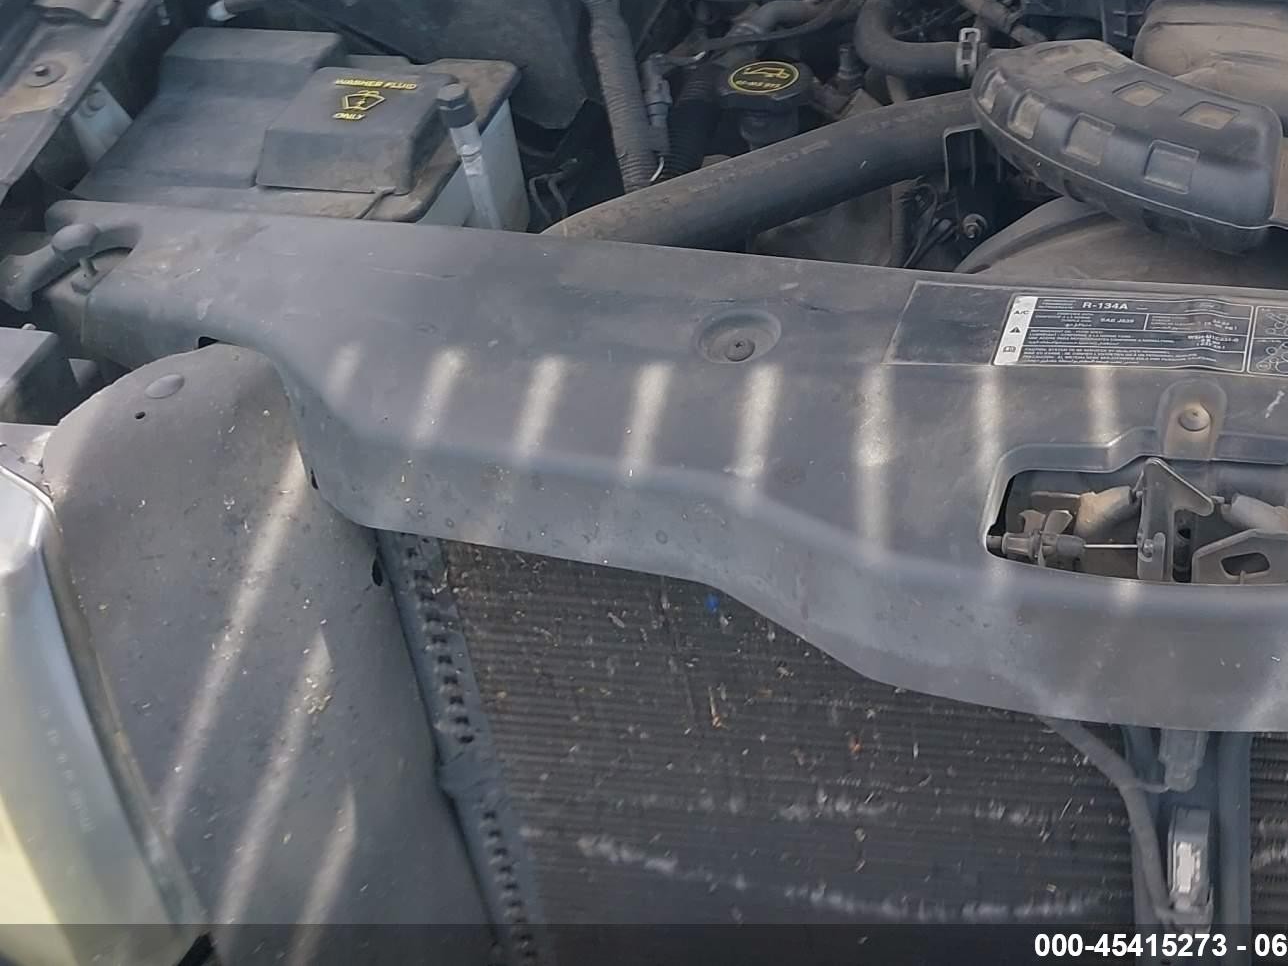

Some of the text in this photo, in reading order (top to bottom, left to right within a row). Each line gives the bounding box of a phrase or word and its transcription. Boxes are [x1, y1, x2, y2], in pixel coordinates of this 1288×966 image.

[335, 79, 417, 90] WASHER FLUID
[1082, 301, 1128, 310] R-134A
